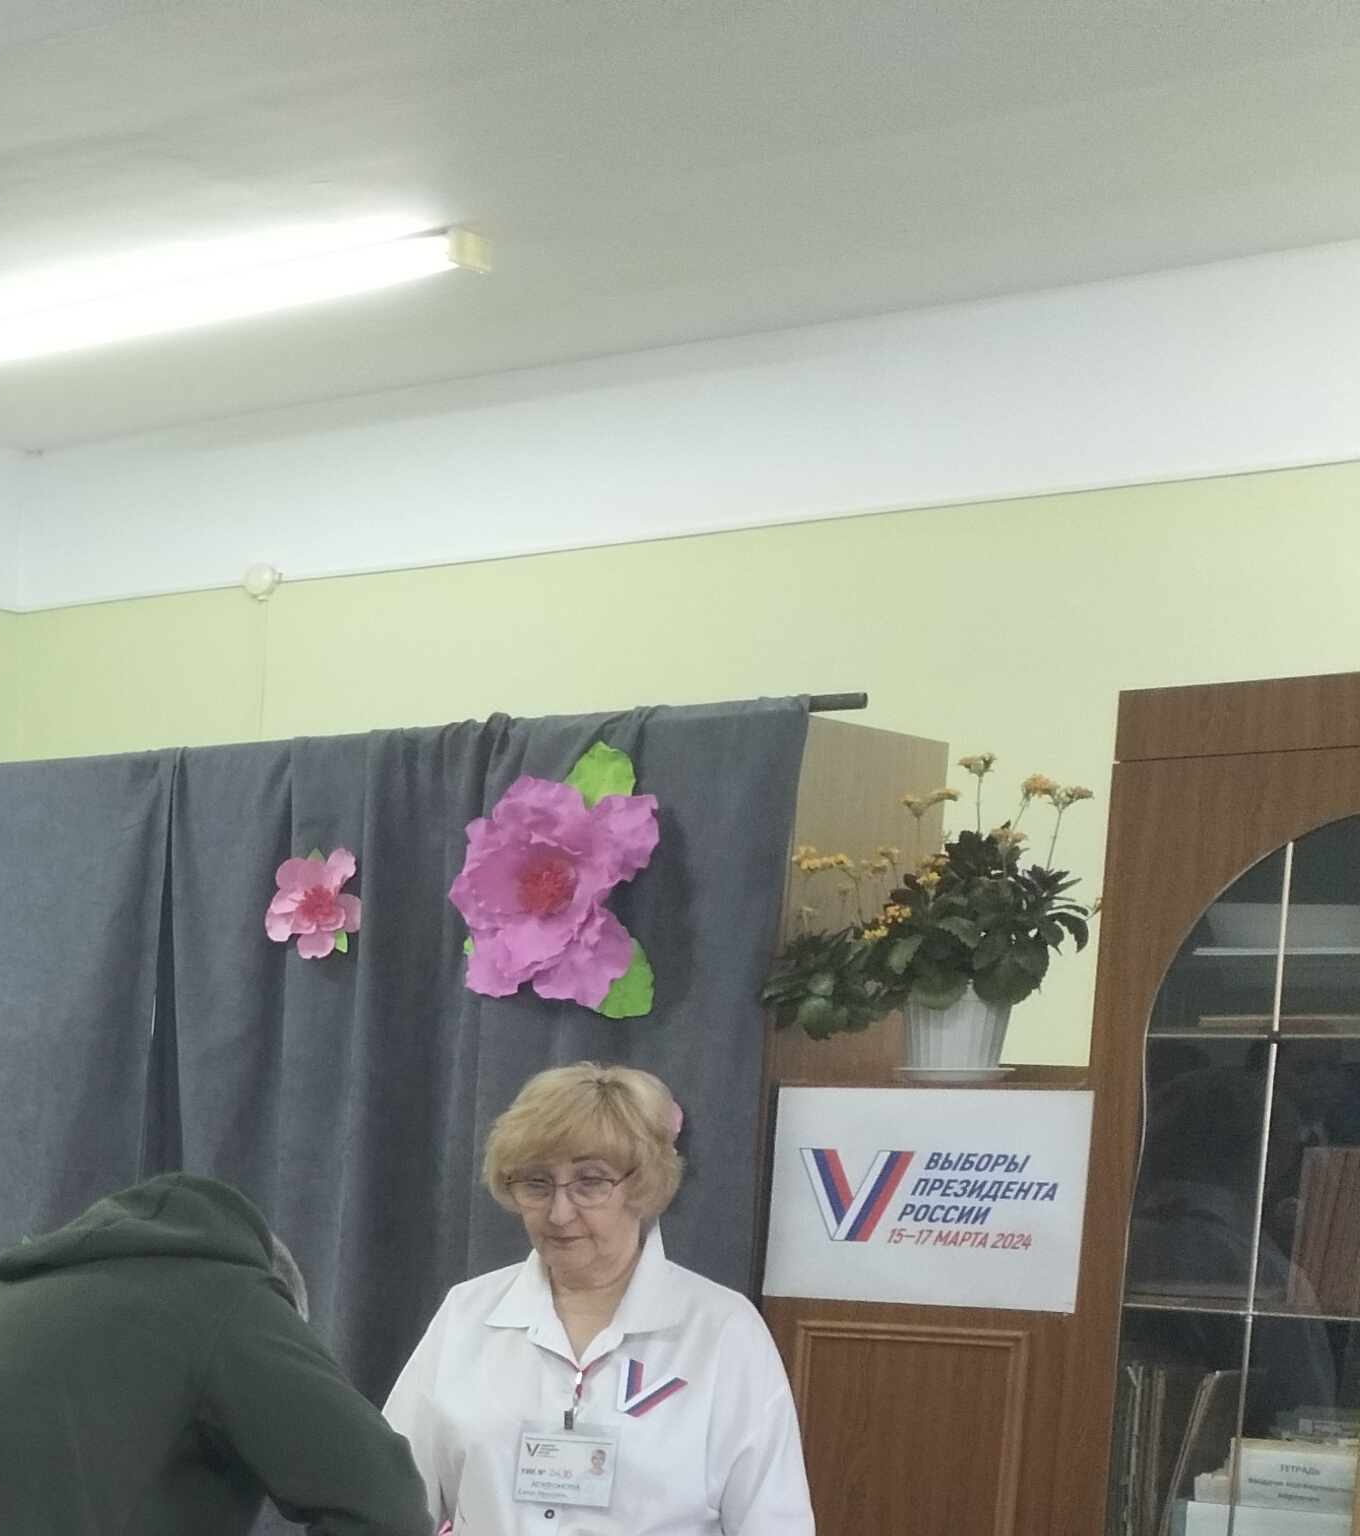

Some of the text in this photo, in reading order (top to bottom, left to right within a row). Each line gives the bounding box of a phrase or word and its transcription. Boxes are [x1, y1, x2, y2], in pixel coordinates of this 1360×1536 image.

[925, 1152, 1030, 1173] ВЫБОРЫ
[911, 1178, 1058, 1201] ПРЕЗИДЕНТА
[898, 1203, 991, 1225] РОССИИ
[934, 1231, 989, 1248] МАРТА
[991, 1233, 1032, 1250] 2024
